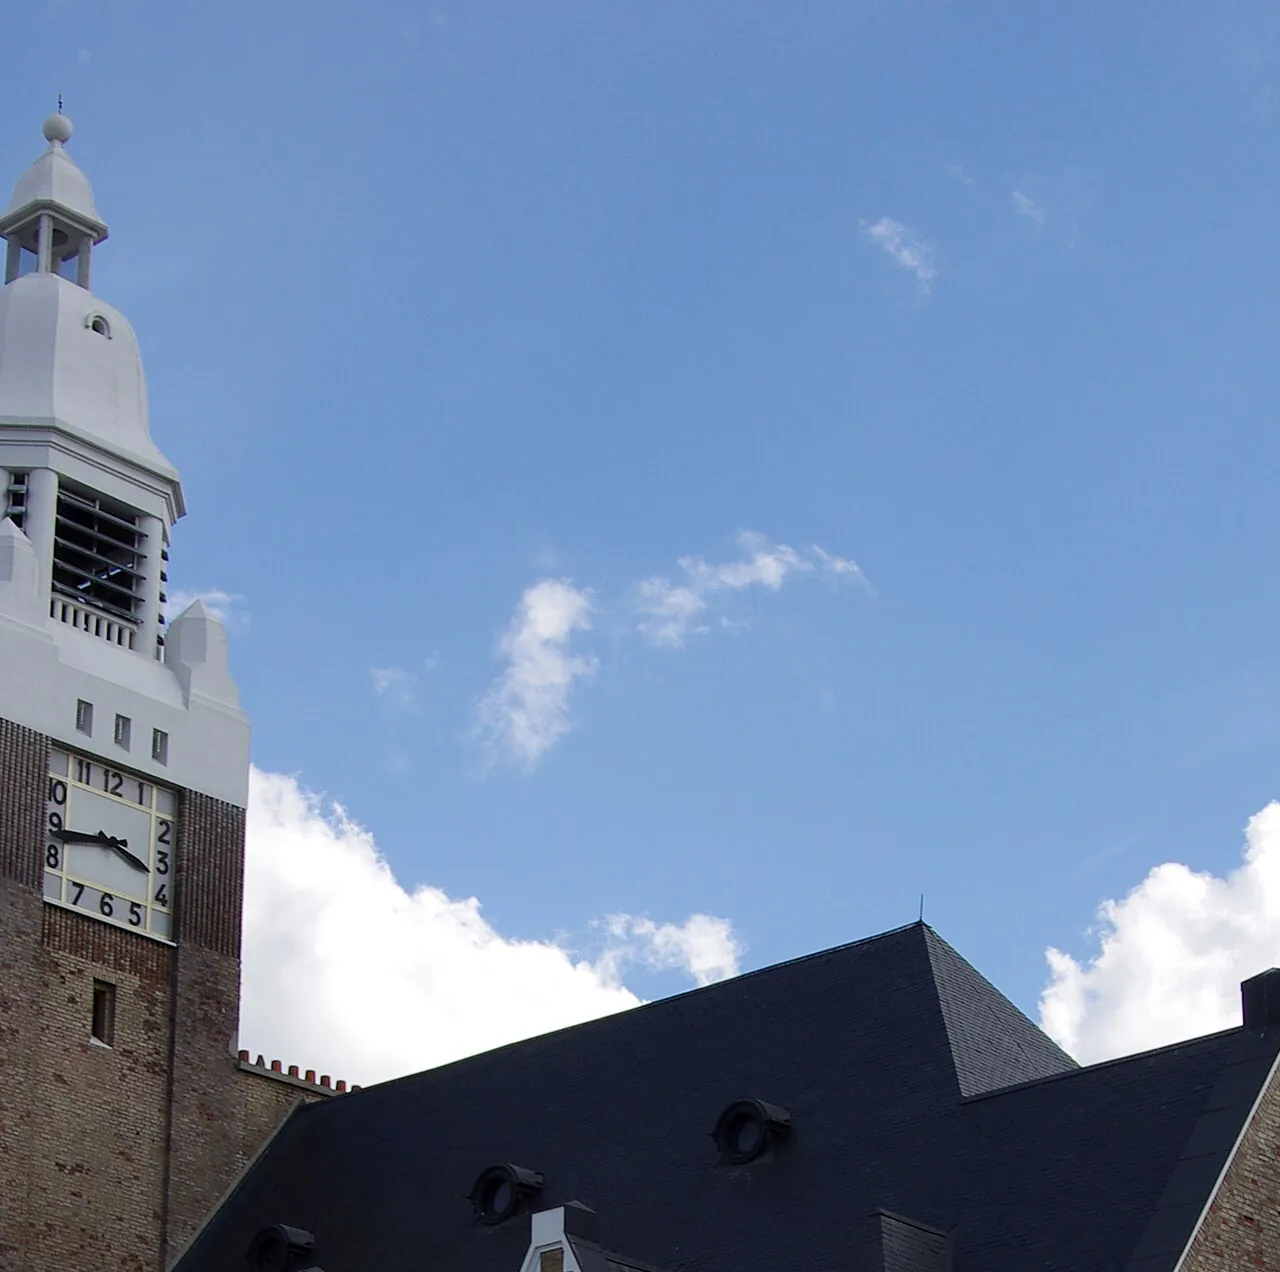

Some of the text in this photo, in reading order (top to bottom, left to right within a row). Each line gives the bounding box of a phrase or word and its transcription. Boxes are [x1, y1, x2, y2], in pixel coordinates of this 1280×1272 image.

[47, 776, 67, 806] 10
[77, 759, 145, 805] 11 12 1
[48, 812, 63, 834] 9
[158, 820, 171, 845] 2
[45, 844, 59, 869] 8
[156, 850, 169, 875] 3
[72, 882, 142, 927] 7 6 5
[154, 884, 168, 907] 4
